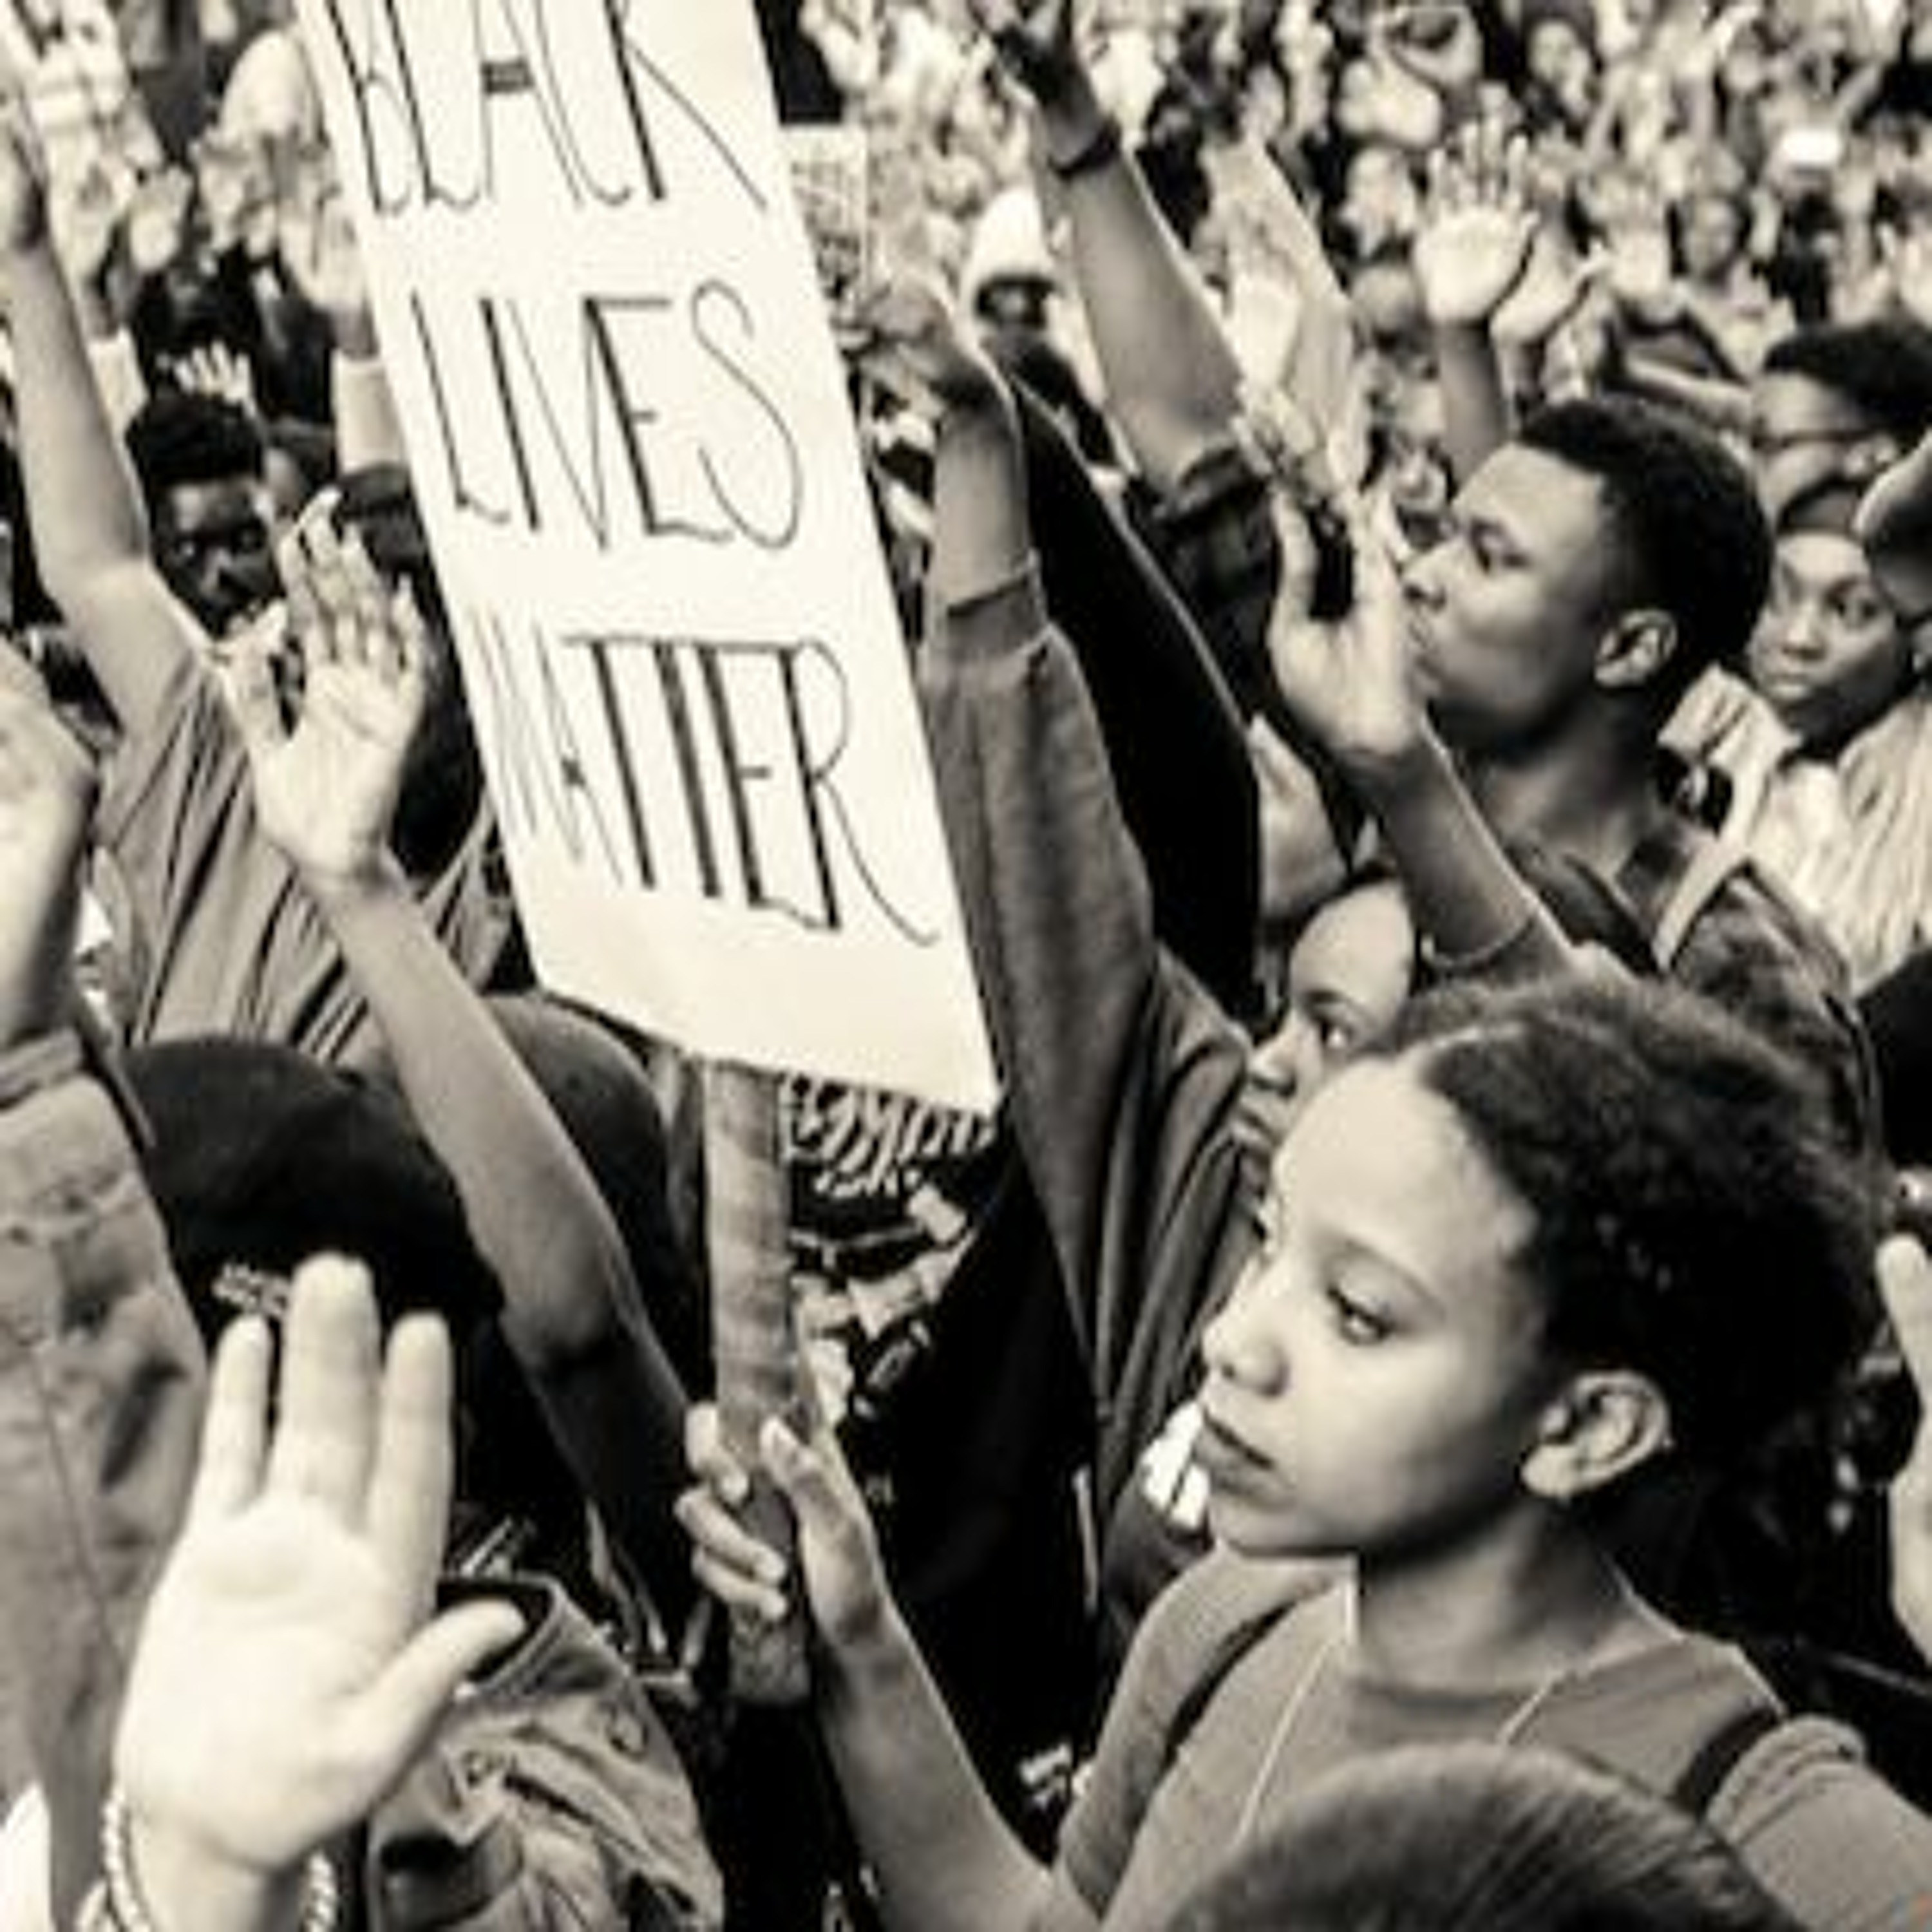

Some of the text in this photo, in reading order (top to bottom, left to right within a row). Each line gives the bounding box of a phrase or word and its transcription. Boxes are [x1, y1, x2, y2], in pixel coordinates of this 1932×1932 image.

[323, 0, 768, 216] BLACK
[410, 278, 803, 551] LIVES
[470, 602, 940, 947] MATTER
